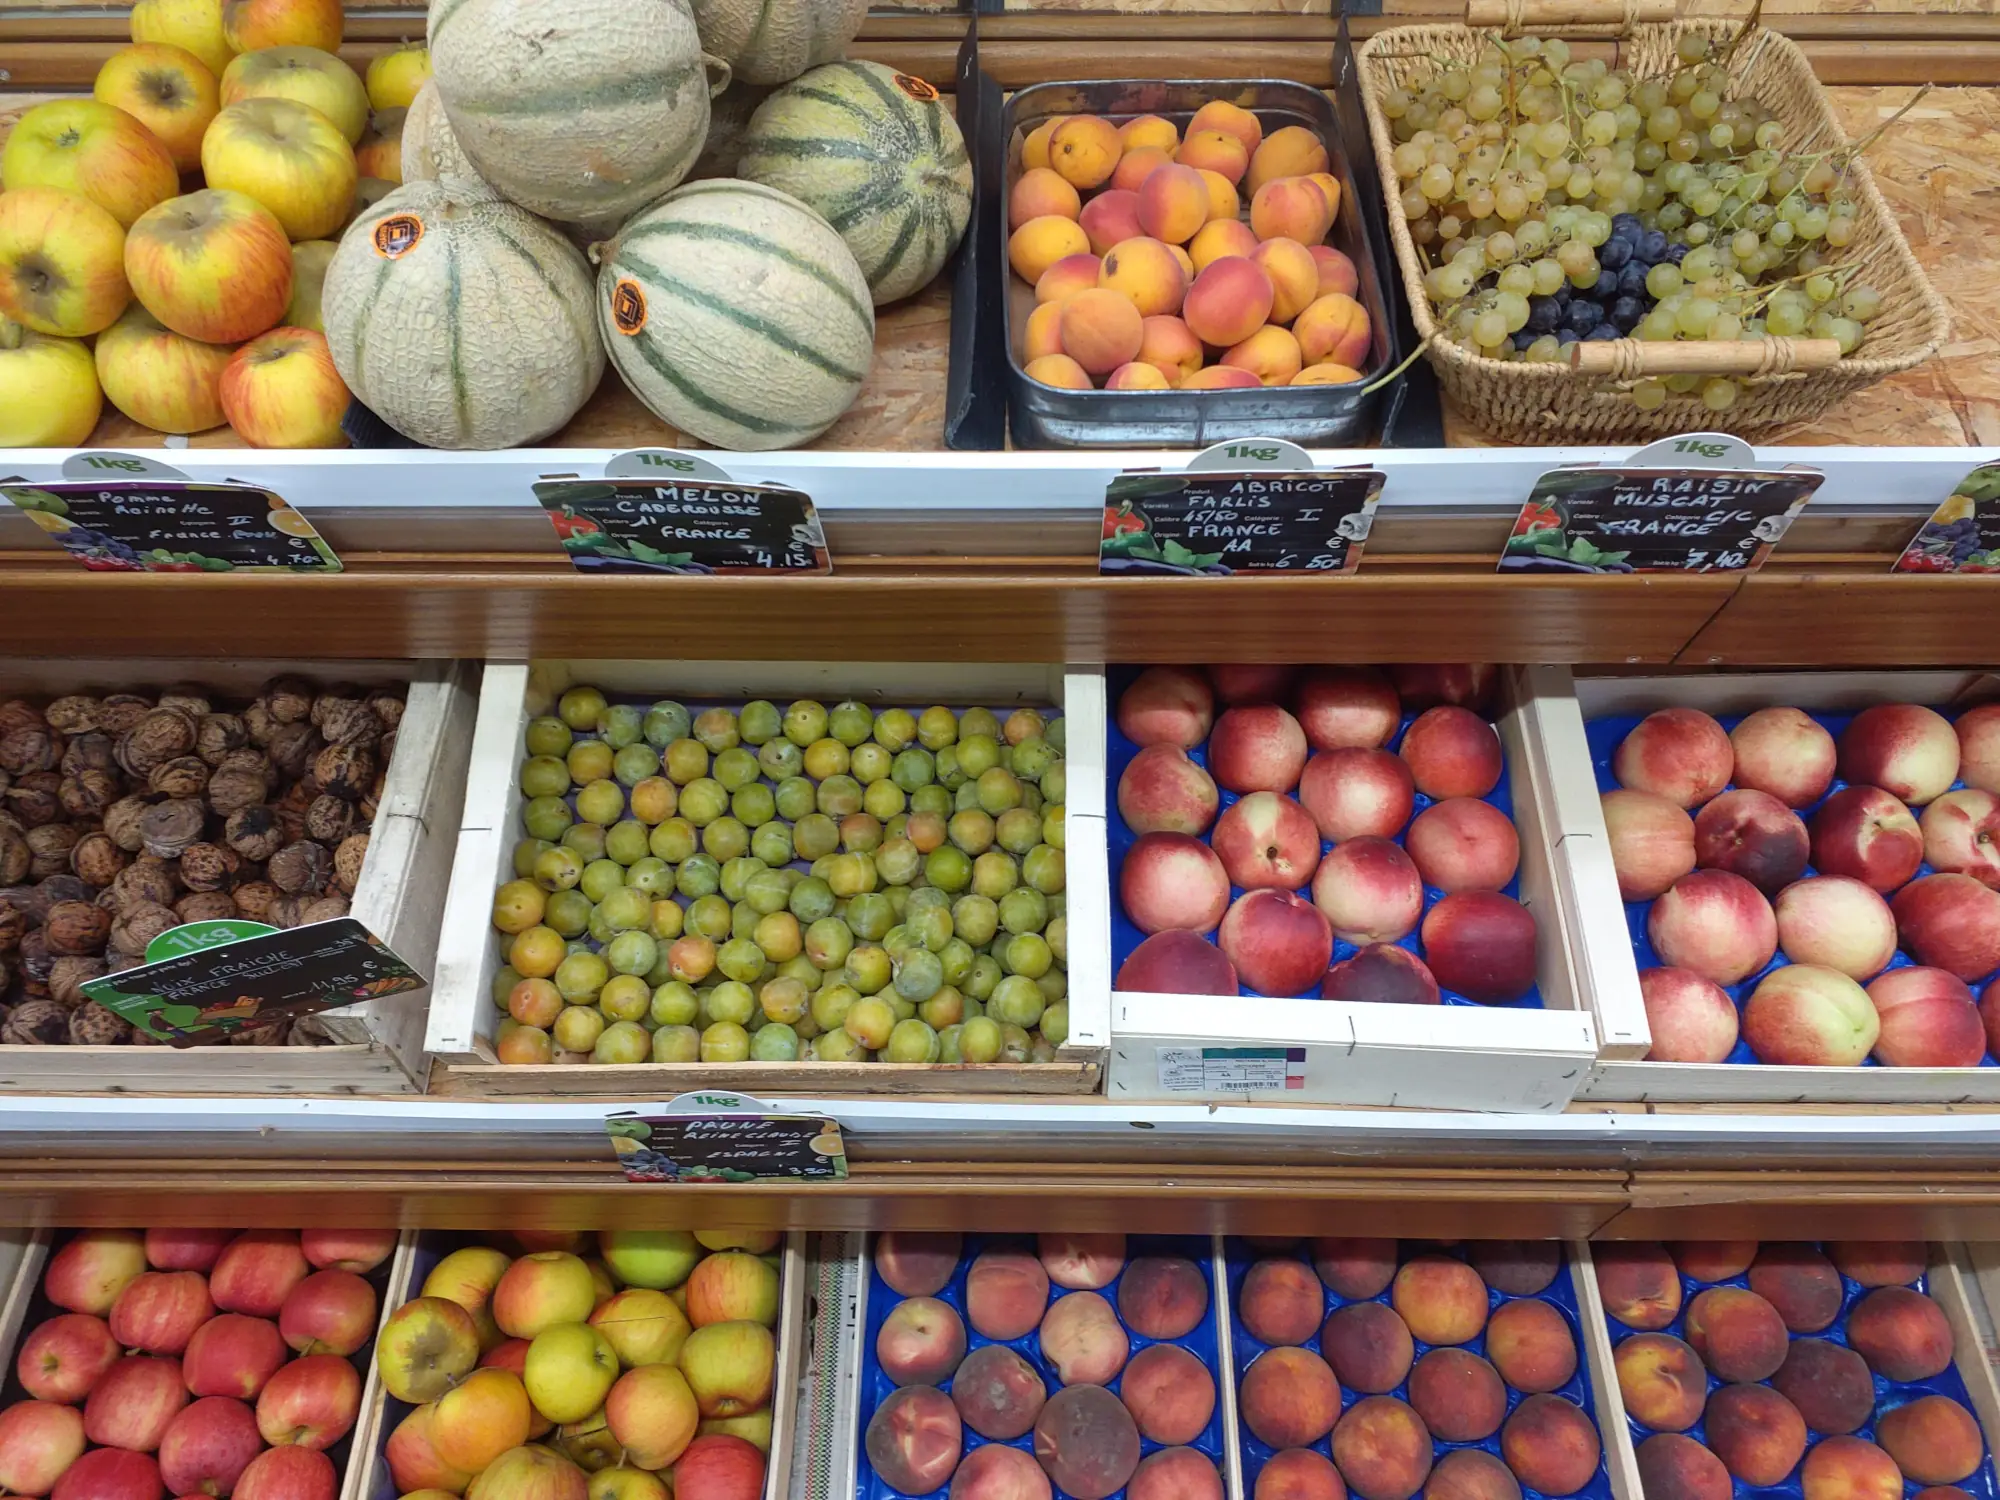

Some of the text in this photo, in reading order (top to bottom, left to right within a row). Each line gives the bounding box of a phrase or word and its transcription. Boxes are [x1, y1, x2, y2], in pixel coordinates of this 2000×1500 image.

[1224, 446, 1281, 461] 1kg
[1673, 439, 1732, 458] 1kg
[81, 456, 147, 472] 1kg
[635, 453, 696, 472] 1kg
[98, 491, 176, 503] Pomme
[655, 486, 761, 504] MELON
[1613, 492, 1735, 508] MUSCAT
[616, 501, 762, 516] CADEROUSSE
[149, 529, 221, 539] France
[661, 525, 752, 539] FRANCE
[1188, 523, 1283, 538] FRANCE
[1596, 518, 1718, 537] FRANCE
[788, 541, 805, 552] €
[1325, 536, 1344, 549] €
[1737, 537, 1757, 549] €
[165, 926, 239, 950] 1kg
[361, 960, 378, 970] €
[168, 979, 232, 1001] FRANCE
[692, 1095, 740, 1108] 1kg
[685, 1121, 776, 1132] PRUNE
[706, 1150, 800, 1158] ESPAGNE
